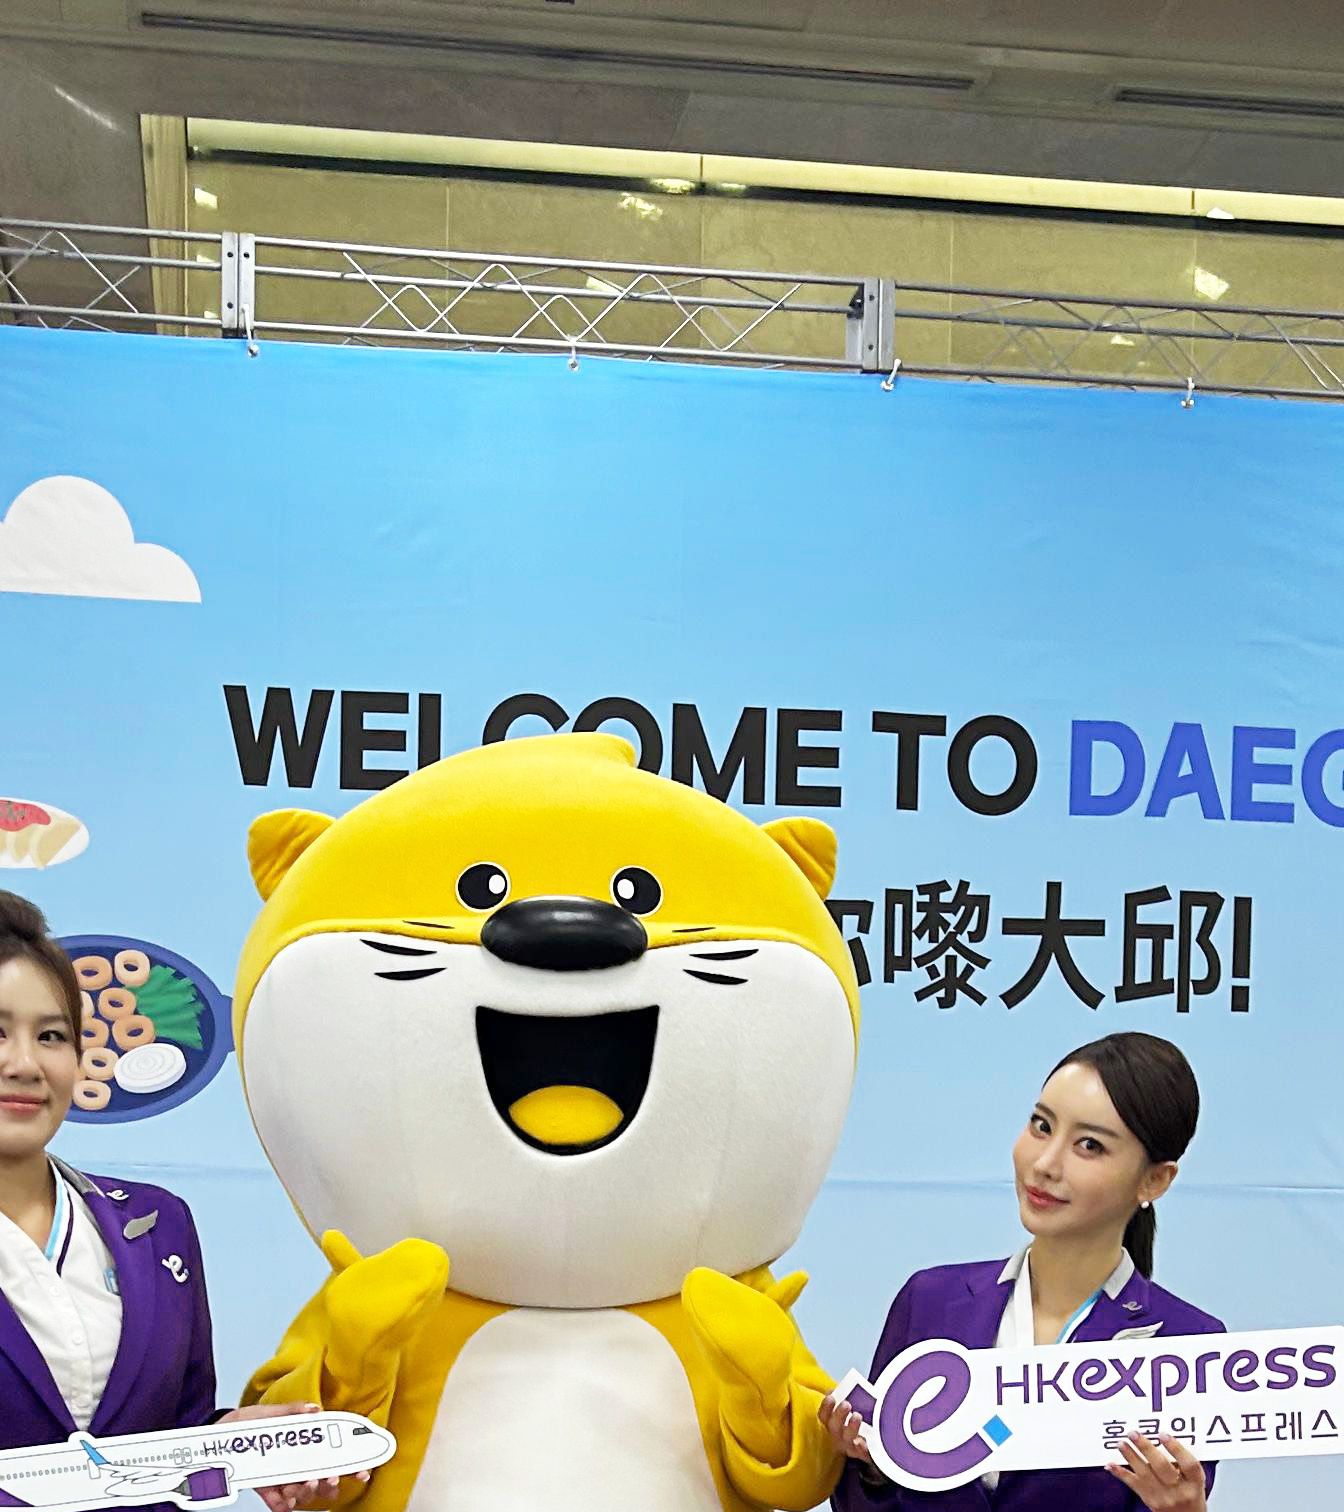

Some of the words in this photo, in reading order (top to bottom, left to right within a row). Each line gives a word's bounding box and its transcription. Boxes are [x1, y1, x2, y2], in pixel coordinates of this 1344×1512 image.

[872, 710, 1037, 817] TO
[996, 1345, 1337, 1412] HKexpress
[203, 1427, 325, 1457] HKexpress
[1102, 1408, 1339, 1450] 홍콩익스프레스
